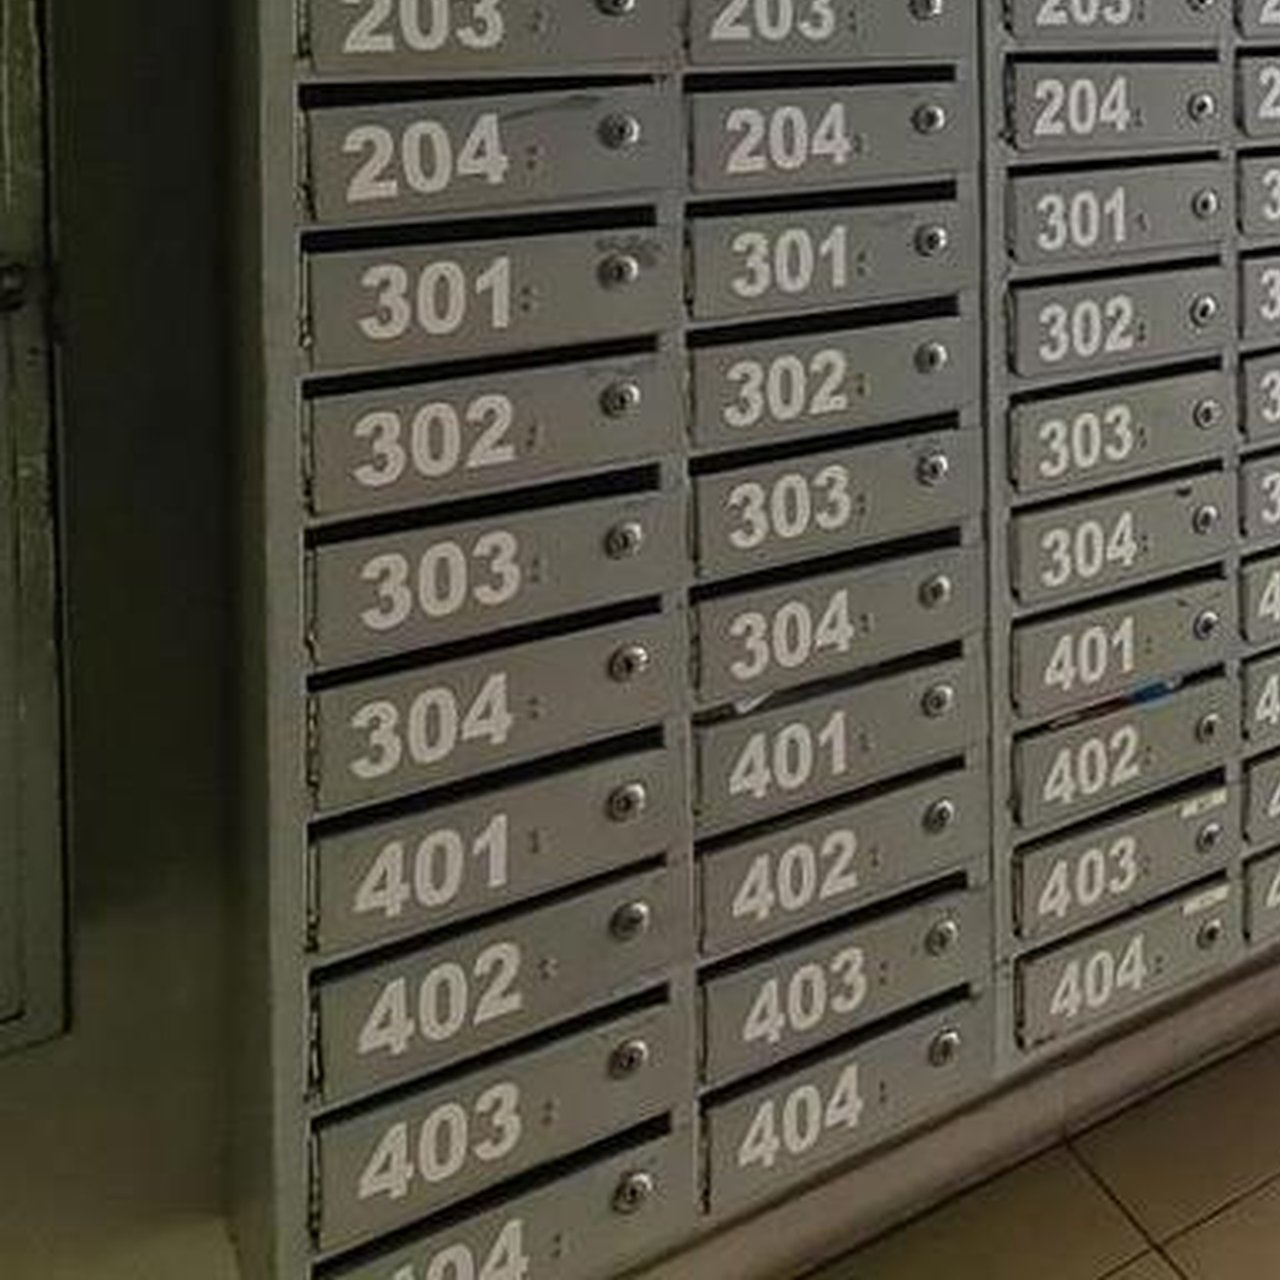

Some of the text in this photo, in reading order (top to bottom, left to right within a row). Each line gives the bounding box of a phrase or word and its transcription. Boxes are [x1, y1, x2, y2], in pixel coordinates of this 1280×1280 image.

[727, 103, 851, 173] 204
[1034, 77, 1130, 135] 204
[343, 113, 509, 202] 204
[1037, 187, 1125, 250] 301
[359, 257, 509, 338] 301
[733, 226, 846, 296] 301
[1040, 296, 1133, 361] 302
[724, 350, 848, 426] 302
[354, 394, 515, 486] 302
[1040, 406, 1133, 476] 303
[728, 465, 851, 547] 303
[362, 531, 520, 629] 303
[1042, 512, 1137, 586] 304
[730, 590, 854, 679] 304
[1045, 617, 1133, 690] 401
[351, 673, 512, 778] 304
[730, 711, 846, 798] 401
[1044, 725, 1139, 804] 402
[354, 814, 507, 917] 401
[733, 830, 858, 920] 402
[1039, 837, 1137, 917] 403
[359, 943, 522, 1054] 402
[744, 948, 866, 1044] 403
[1050, 935, 1147, 1017] 404
[359, 1083, 520, 1199] 403
[739, 1065, 863, 1167] 404
